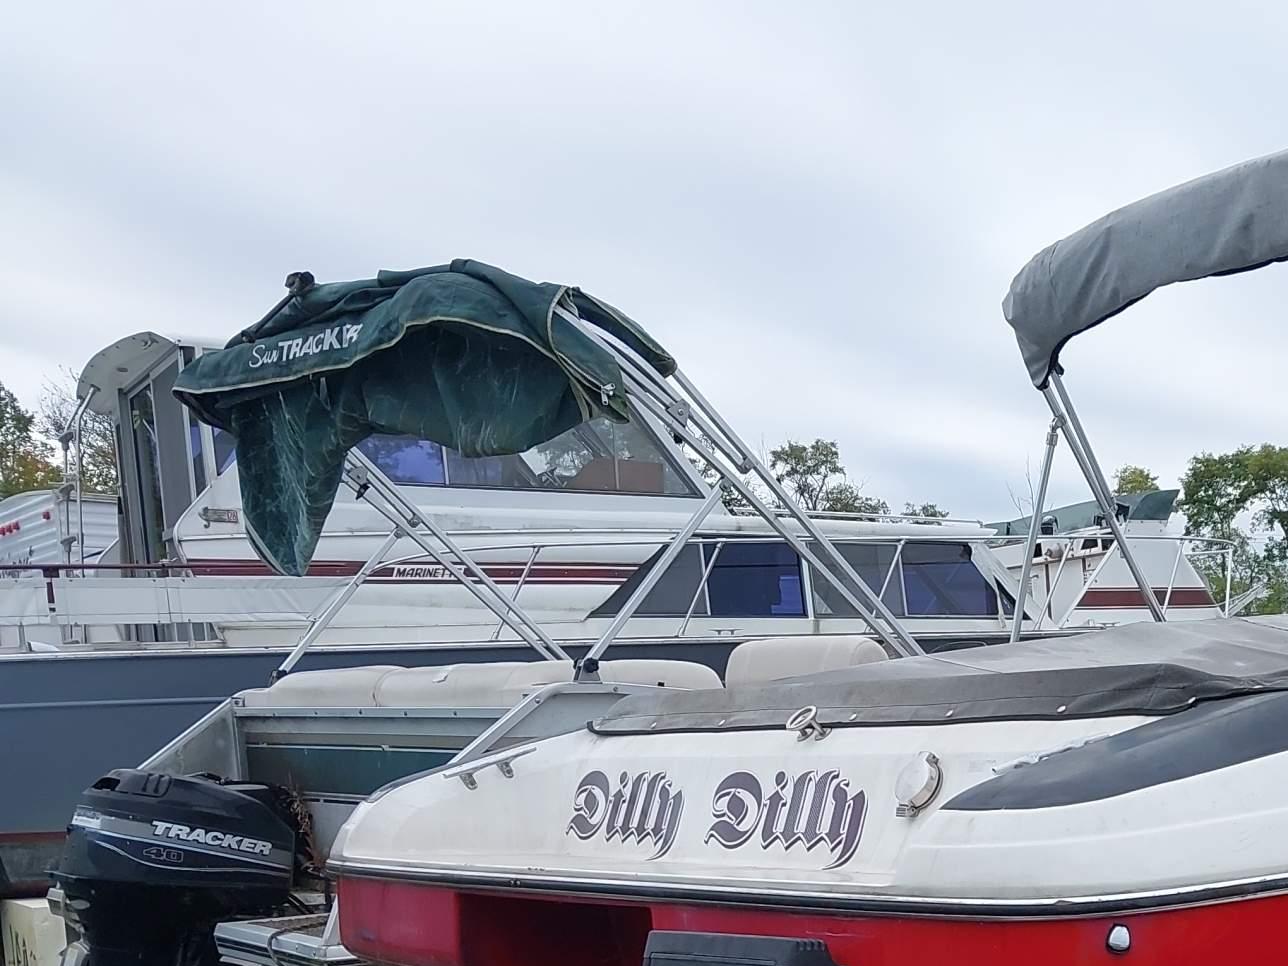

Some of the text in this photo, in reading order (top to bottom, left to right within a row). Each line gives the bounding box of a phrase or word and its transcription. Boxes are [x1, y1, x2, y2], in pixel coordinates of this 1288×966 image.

[565, 768, 869, 871] Dilly Dilly
[142, 847, 184, 862] 40
[150, 820, 273, 856] TRACKER
